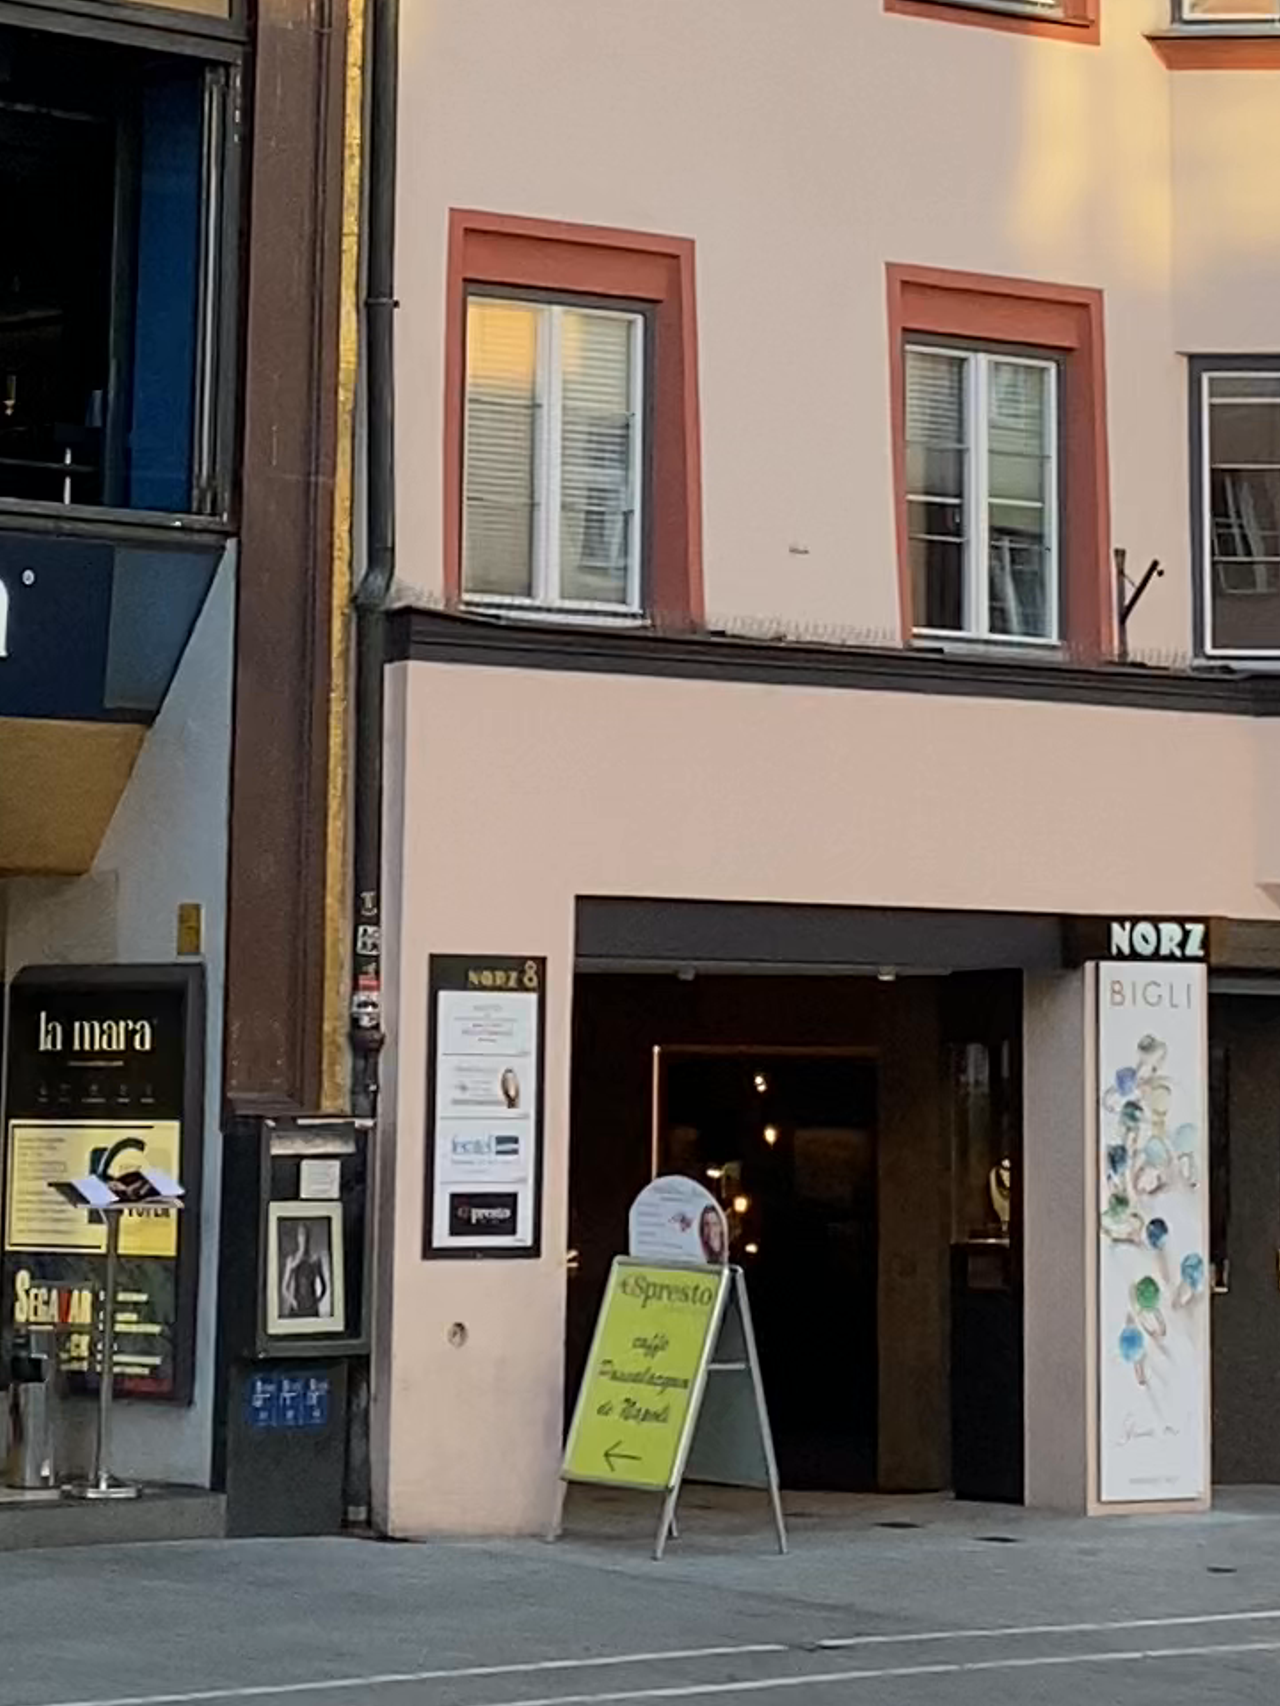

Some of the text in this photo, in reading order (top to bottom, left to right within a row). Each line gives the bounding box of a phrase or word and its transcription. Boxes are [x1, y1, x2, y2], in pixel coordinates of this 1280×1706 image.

[1110, 920, 1206, 958] NORZ
[1110, 979, 1192, 1010] BIGLI
[38, 1010, 153, 1052] la mara
